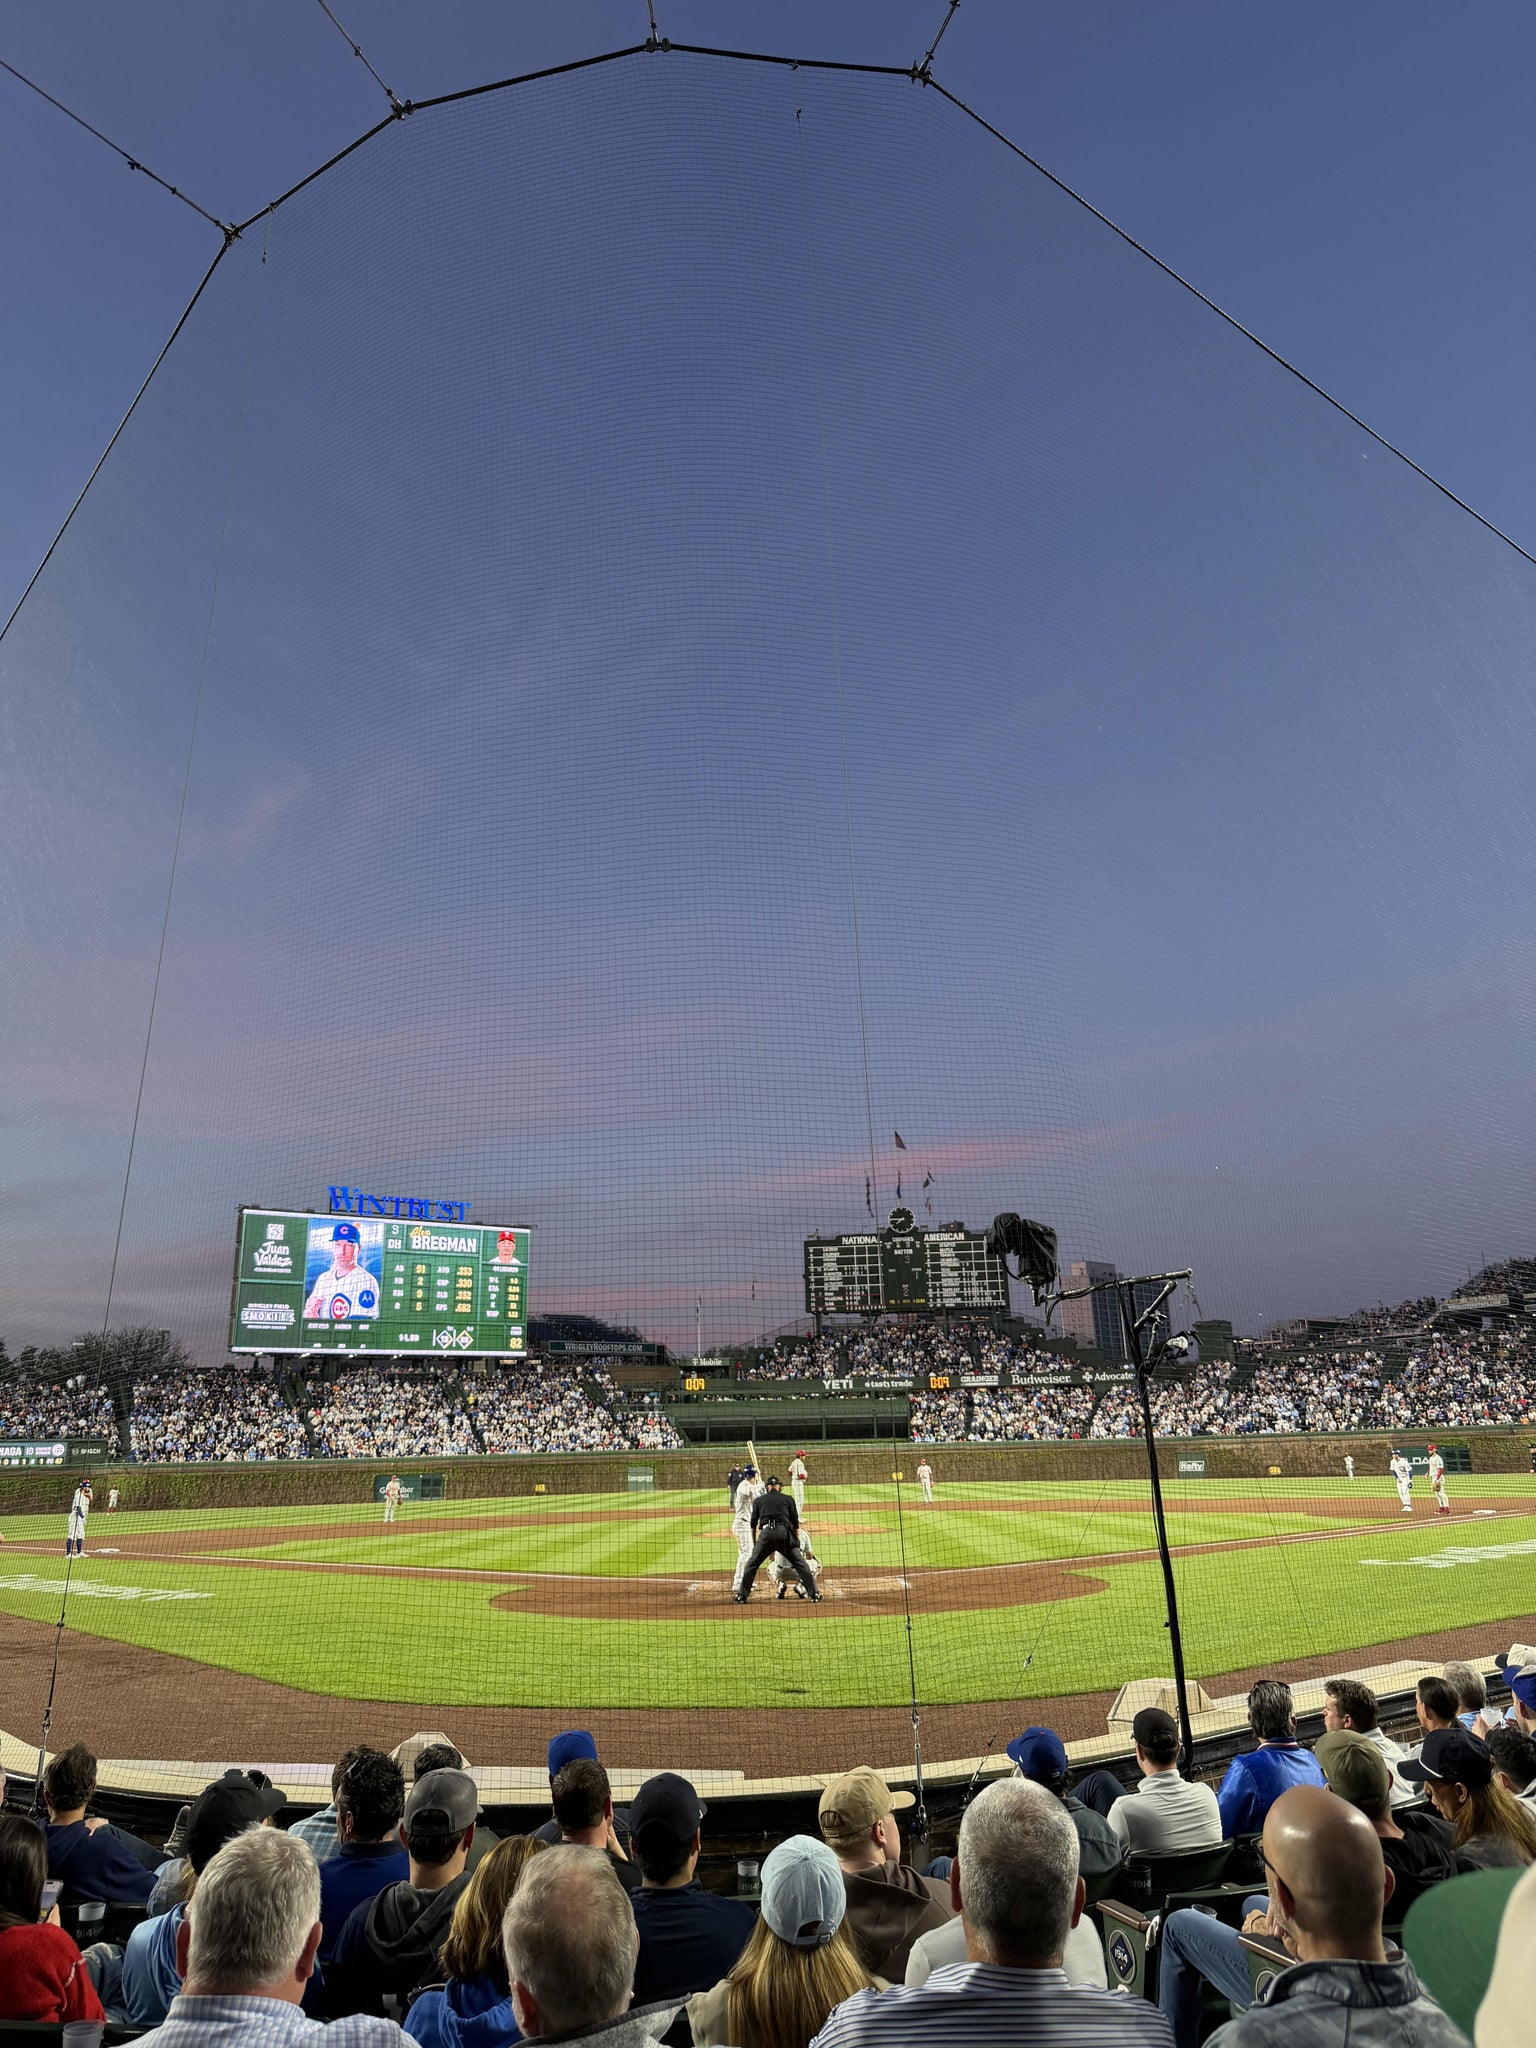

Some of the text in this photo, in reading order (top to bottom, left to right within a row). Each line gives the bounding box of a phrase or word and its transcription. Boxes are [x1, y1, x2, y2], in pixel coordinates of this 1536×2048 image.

[327, 1185, 472, 1222] WINTRUST
[391, 1225, 399, 1235] 3
[841, 1236, 882, 1245] NATIONA
[924, 1233, 965, 1241] AMERICAN
[259, 1241, 289, 1255] Juan
[387, 1239, 401, 1249] DH
[412, 1236, 477, 1253] BREGMAN
[253, 1251, 293, 1267] Valdez
[417, 1277, 424, 1286] 2
[242, 1310, 295, 1321] SMOKIES
[510, 1338, 522, 1349] 82
[564, 1342, 643, 1352] WRIGLEYROOFTOPS.COM
[700, 1357, 723, 1366] Mobile
[960, 1375, 999, 1383] GRAINGER
[1012, 1374, 1071, 1385] Budweiser
[1094, 1372, 1133, 1381] Advocate
[686, 1378, 705, 1391] 0:09
[822, 1380, 853, 1389] YETI
[930, 1377, 950, 1389] 0:09
[1180, 1462, 1203, 1470] Hefty
[1114, 1947, 1128, 1963] 1914
